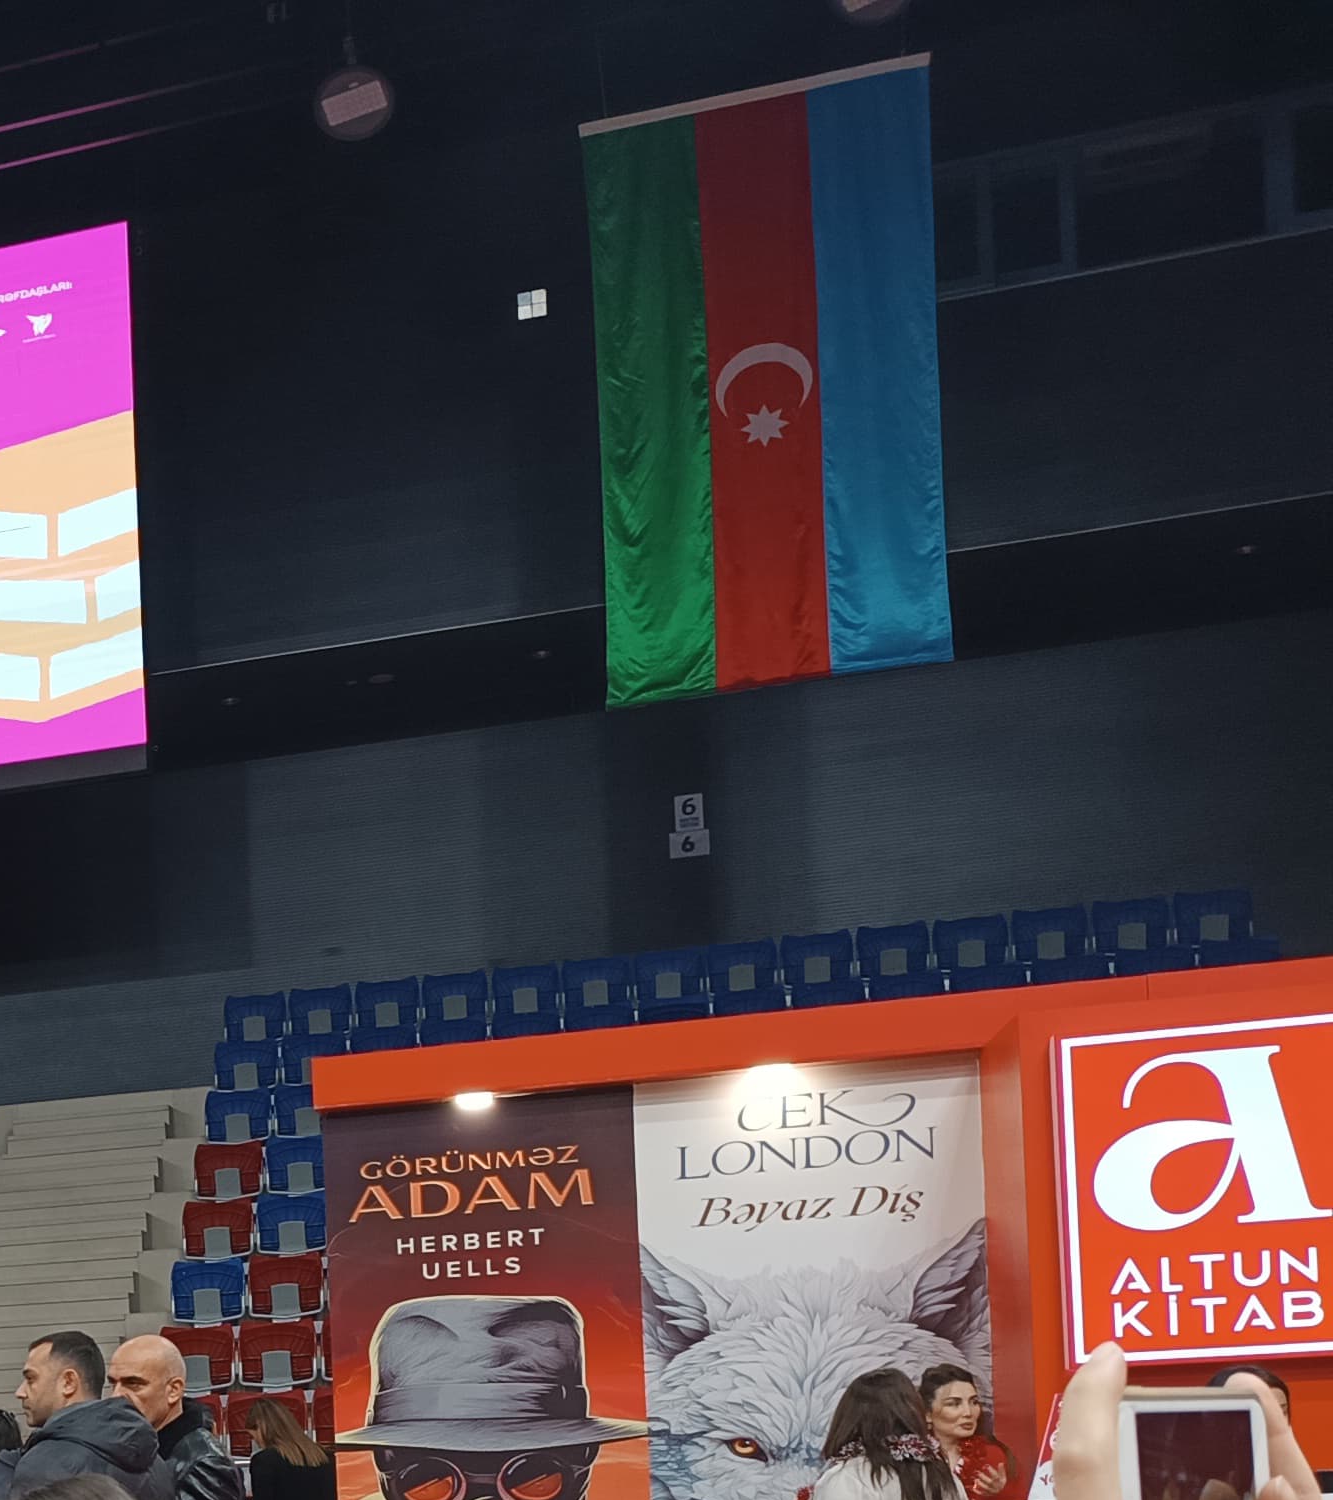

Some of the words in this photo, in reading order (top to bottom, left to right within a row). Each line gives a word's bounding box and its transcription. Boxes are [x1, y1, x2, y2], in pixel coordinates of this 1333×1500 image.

[681, 797, 696, 816] 6
[681, 835, 696, 853] 6
[358, 1142, 581, 1181] GÖRÜNMƏZ
[675, 1125, 938, 1182] LONDON
[347, 1166, 596, 1225] ADAM
[691, 1196, 836, 1232] Bəyaz
[841, 1181, 925, 1224] Diş
[394, 1225, 546, 1257] HERBERT
[420, 1254, 523, 1283] UELLS
[1109, 1245, 1322, 1296] ALTUN
[1111, 1283, 1327, 1338] KİTAB
